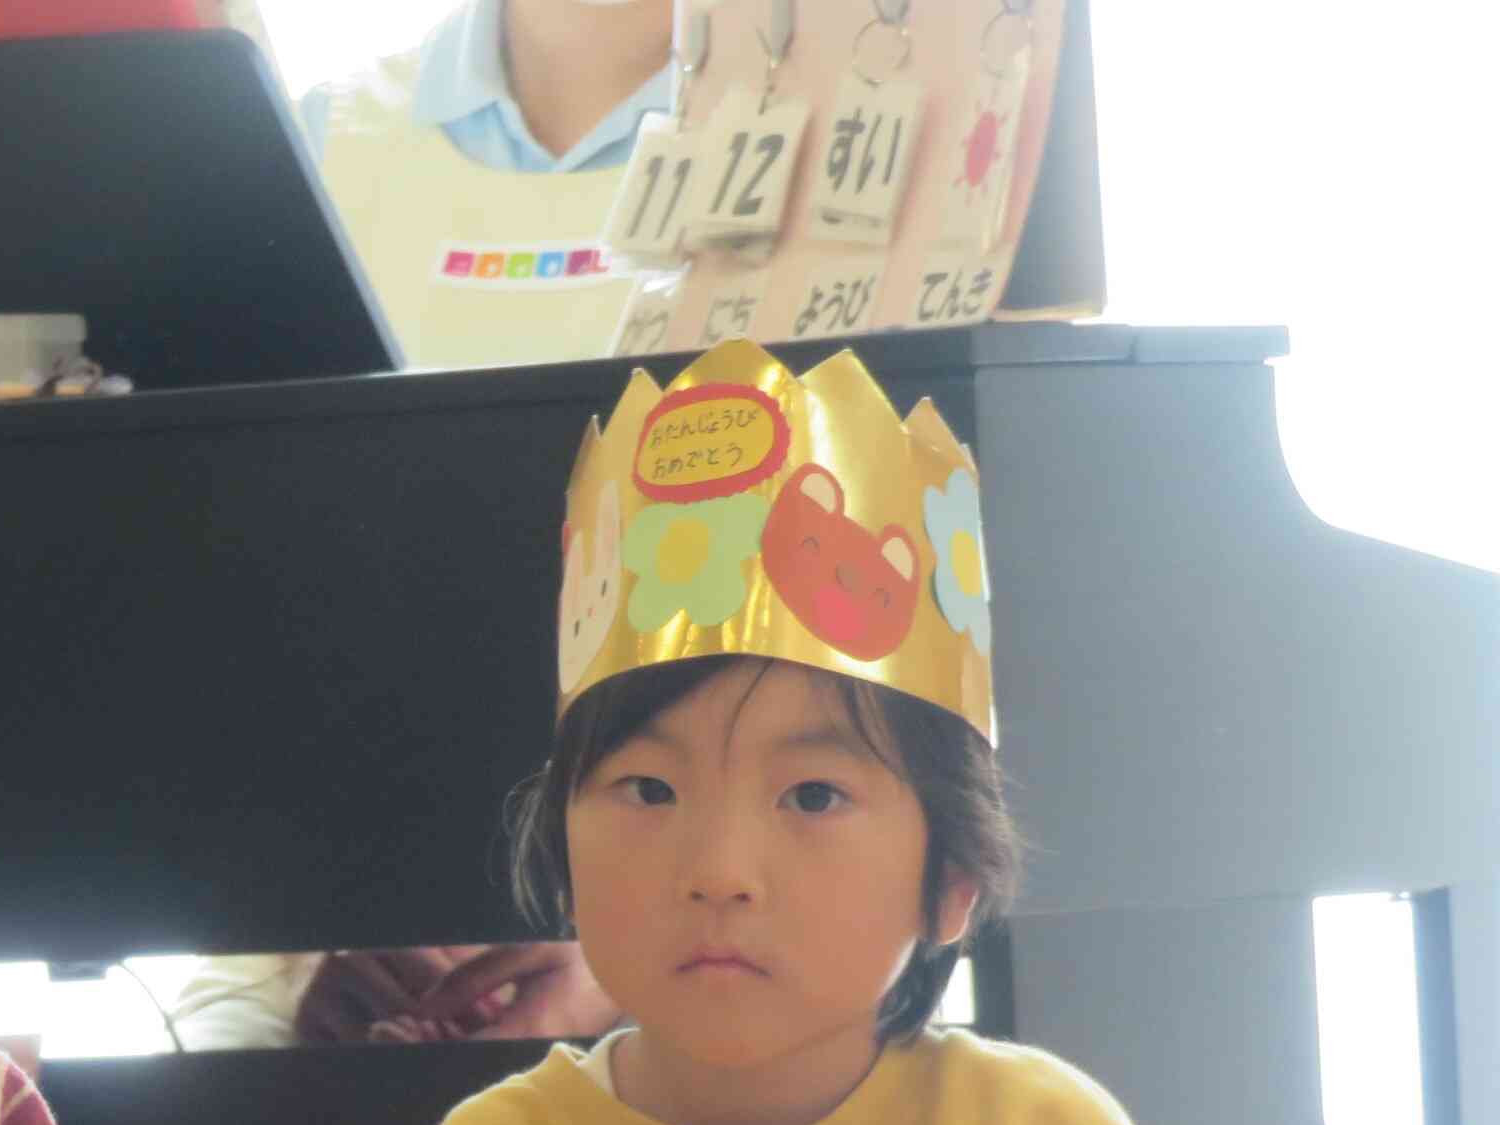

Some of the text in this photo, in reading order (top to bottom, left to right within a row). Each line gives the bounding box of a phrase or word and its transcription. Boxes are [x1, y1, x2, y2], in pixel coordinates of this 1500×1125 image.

[708, 131, 786, 216] 12
[826, 107, 902, 194] すい
[626, 154, 692, 239] 11
[794, 273, 876, 336] ようび
[917, 267, 993, 322] てんき
